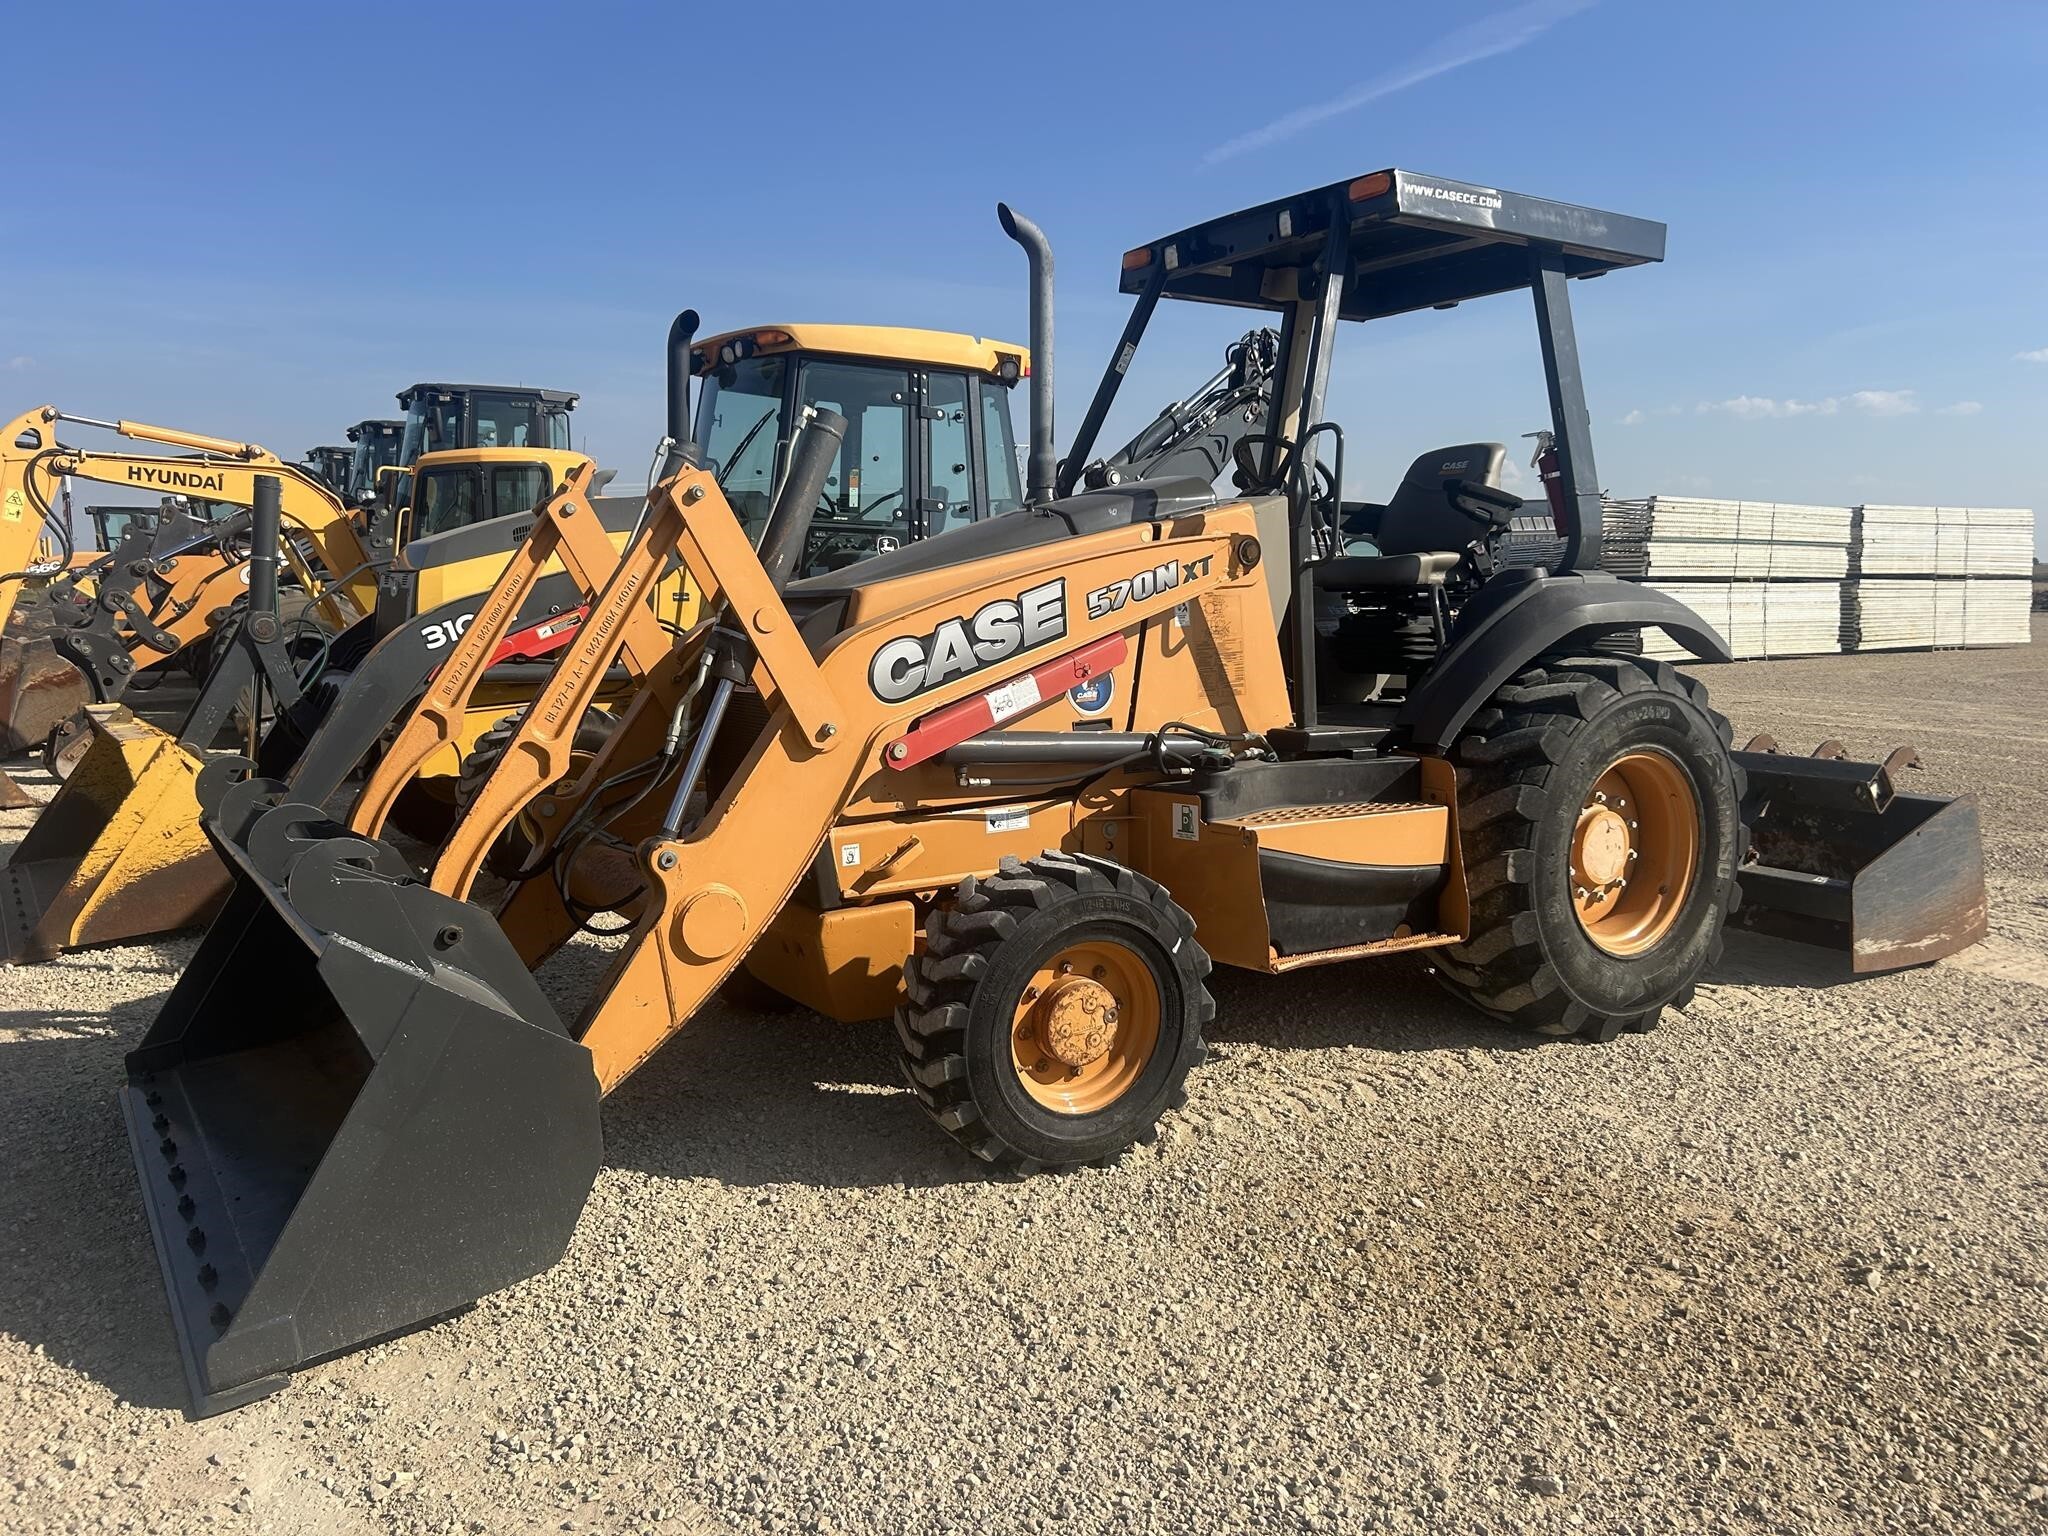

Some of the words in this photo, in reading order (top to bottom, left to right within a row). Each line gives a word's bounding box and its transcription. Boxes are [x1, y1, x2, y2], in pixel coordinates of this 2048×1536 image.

[1404, 183, 1502, 209] WWW.CASECE.COM
[128, 465, 224, 491] HYUNDAI
[1442, 460, 1470, 470] CASE
[1086, 559, 1179, 620] 570N
[1182, 554, 1214, 585] XT
[869, 577, 1066, 703] CASE
